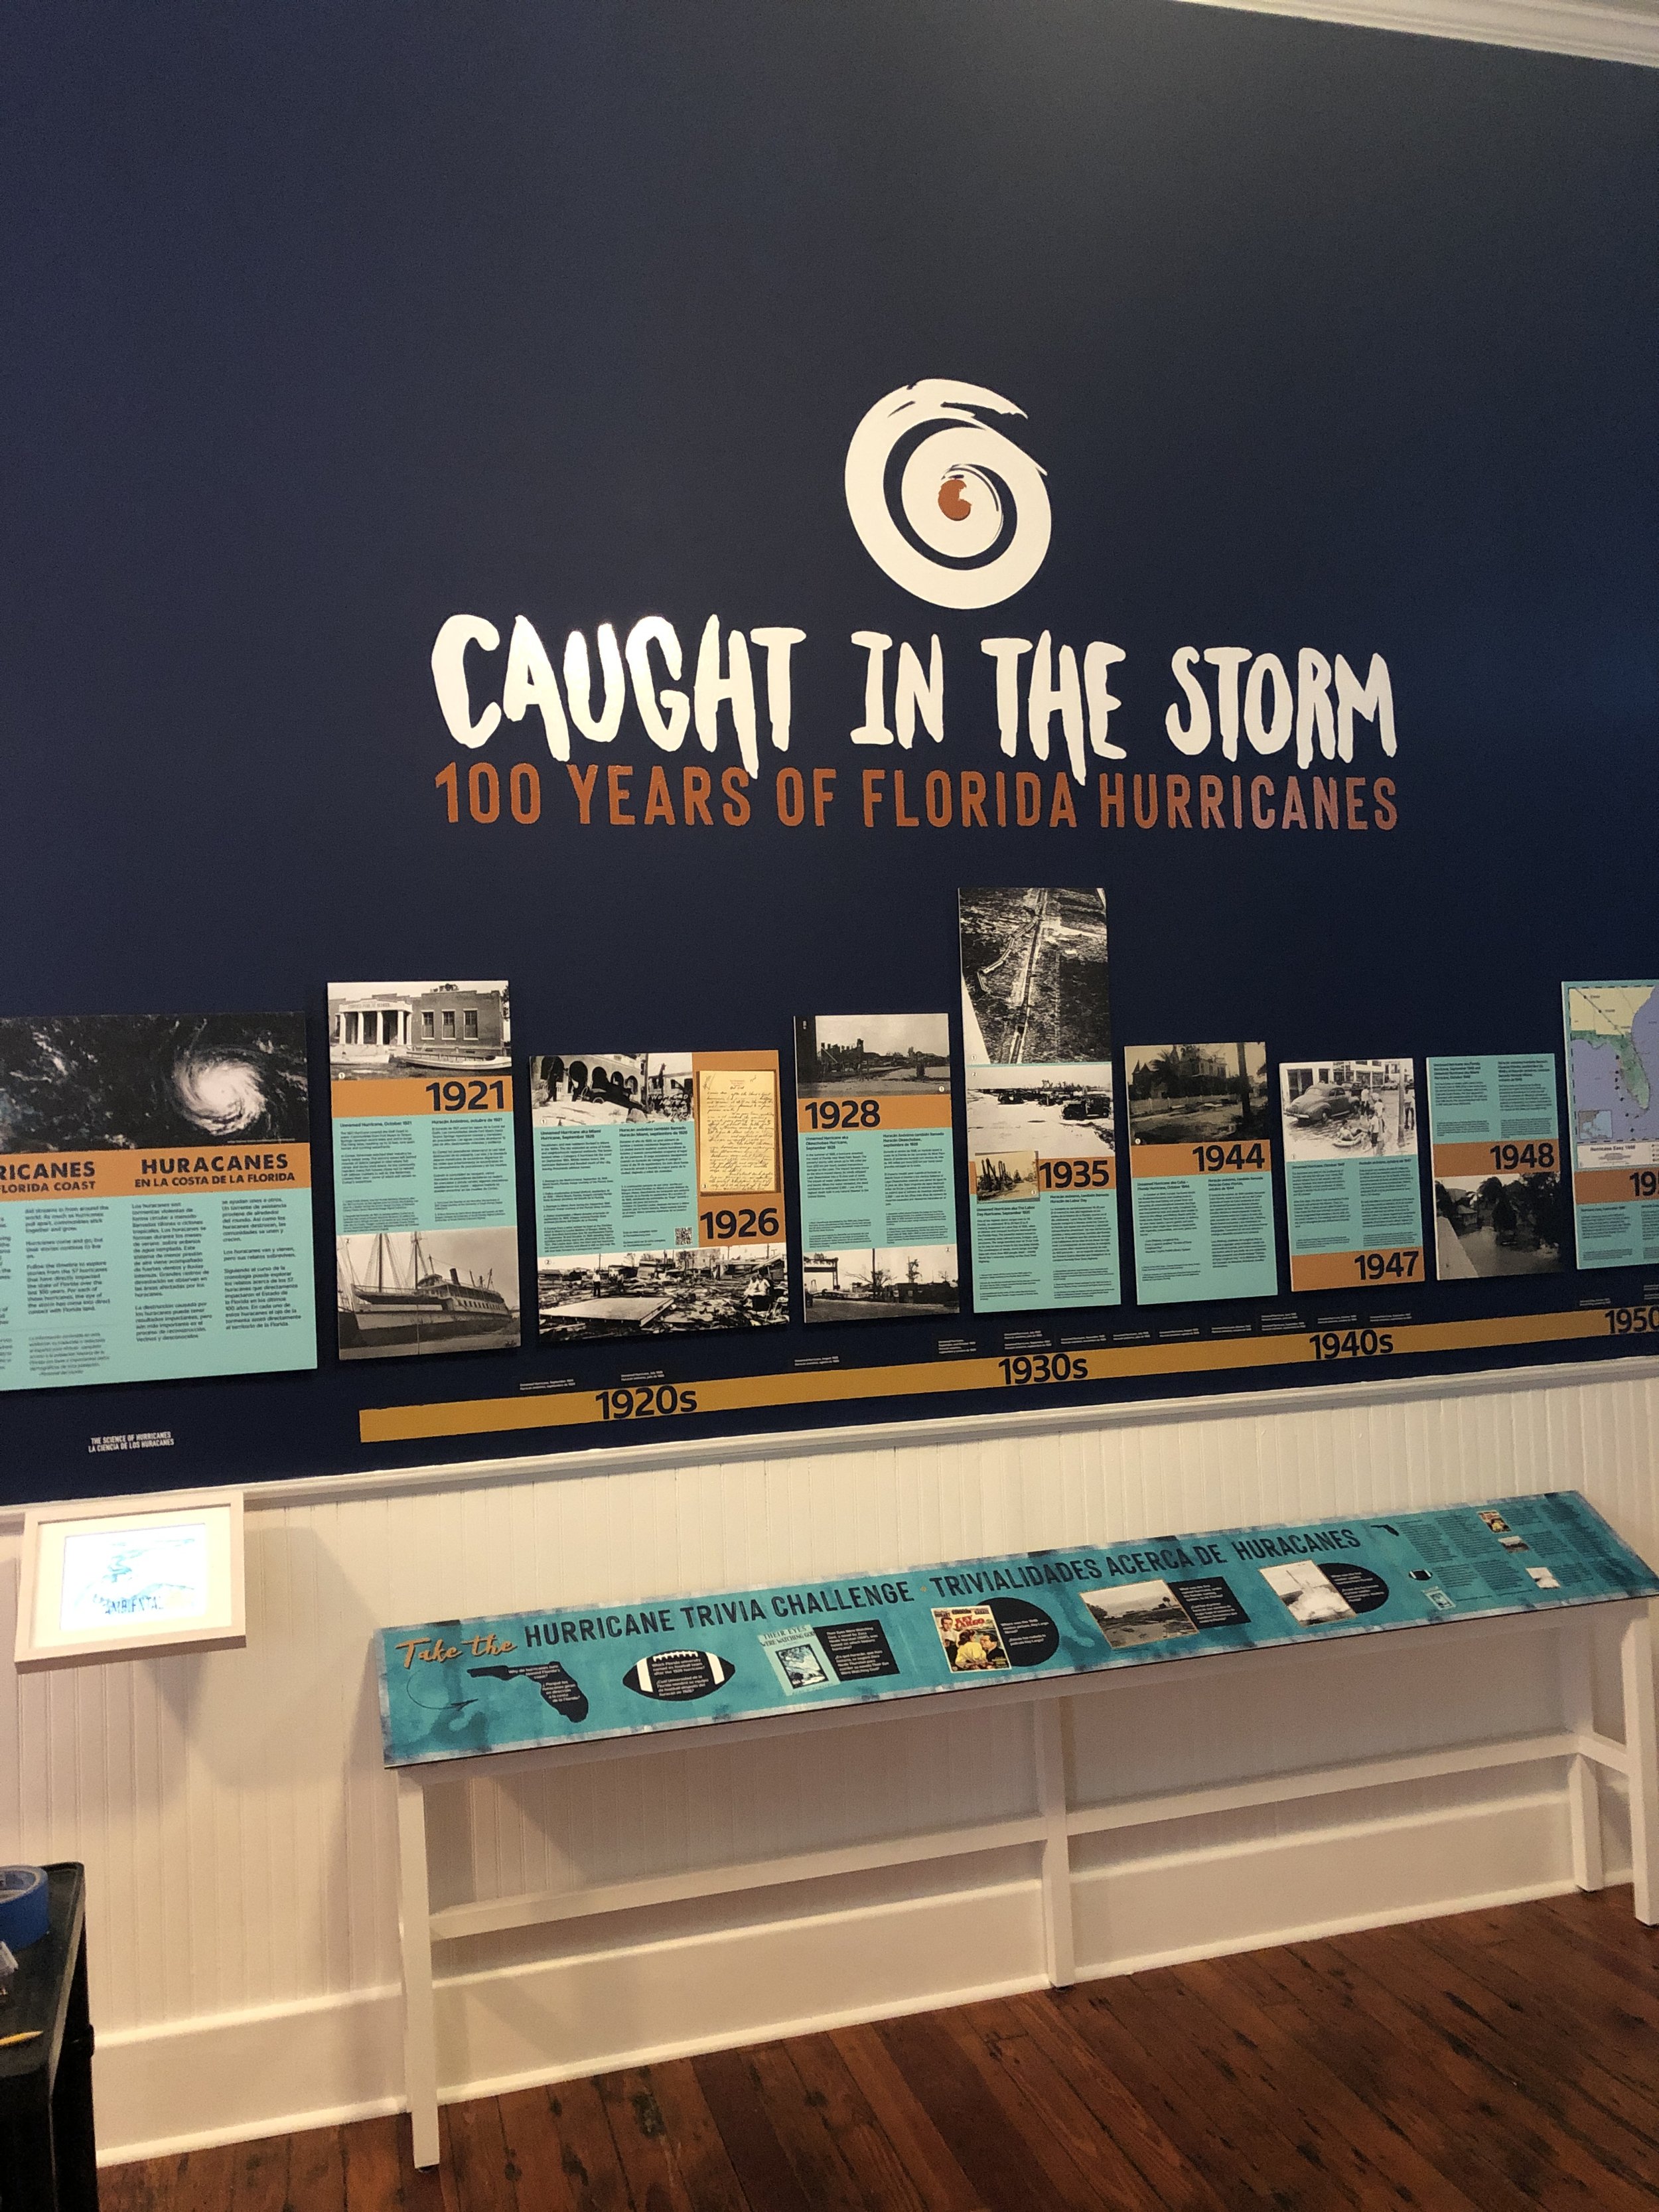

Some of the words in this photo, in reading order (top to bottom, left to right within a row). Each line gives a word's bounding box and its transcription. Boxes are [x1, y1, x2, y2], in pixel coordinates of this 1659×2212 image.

[431, 615, 806, 778] CAUGHT
[851, 631, 944, 749] IN
[981, 630, 1126, 785] THE
[1165, 646, 1397, 769] STORM
[435, 762, 540, 824] 100
[567, 765, 750, 826] YEARS
[776, 767, 836, 826] OF
[863, 769, 1076, 827] FLORIDA
[1100, 773, 1396, 829] HURRICANES
[425, 1080, 504, 1112] 1921
[805, 1100, 881, 1129] 1928
[141, 1153, 288, 1175] HURACANES
[1192, 1143, 1265, 1172] 1944
[1490, 1142, 1555, 1170] 1948
[54, 1181, 96, 1191] COAST
[135, 1178, 151, 1187] EN
[154, 1177, 168, 1187] LA
[171, 1176, 209, 1186] COSTA
[212, 1175, 226, 1184] DE
[230, 1174, 245, 1183] LA
[248, 1172, 295, 1183] FLORIDA
[1039, 1160, 1109, 1189] 1935
[1629, 1171, 1659, 1197] 19
[700, 1208, 779, 1240] 1926
[1354, 1252, 1419, 1280] 1947
[1309, 1330, 1394, 1361] 1940s
[999, 1353, 1088, 1386] 1930s
[595, 1386, 697, 1420] 1920s
[136, 1432, 171, 1441] HURRICANES
[141, 1439, 174, 1448] HURACANES
[930, 1560, 1103, 1597] TRIVIALIDADES
[1109, 1548, 1196, 1577] ACERCA
[1196, 1544, 1228, 1566] DE
[1231, 1529, 1361, 1561] HURACANES
[395, 1637, 463, 1669] Take
[461, 1632, 518, 1657] the
[524, 1609, 670, 1648] HURRICANE
[681, 1598, 766, 1630] TRIVIA
[772, 1581, 914, 1618] CHALLENGE
[762, 1630, 786, 1640] THEIR
[776, 1633, 804, 1643] WATCHING
